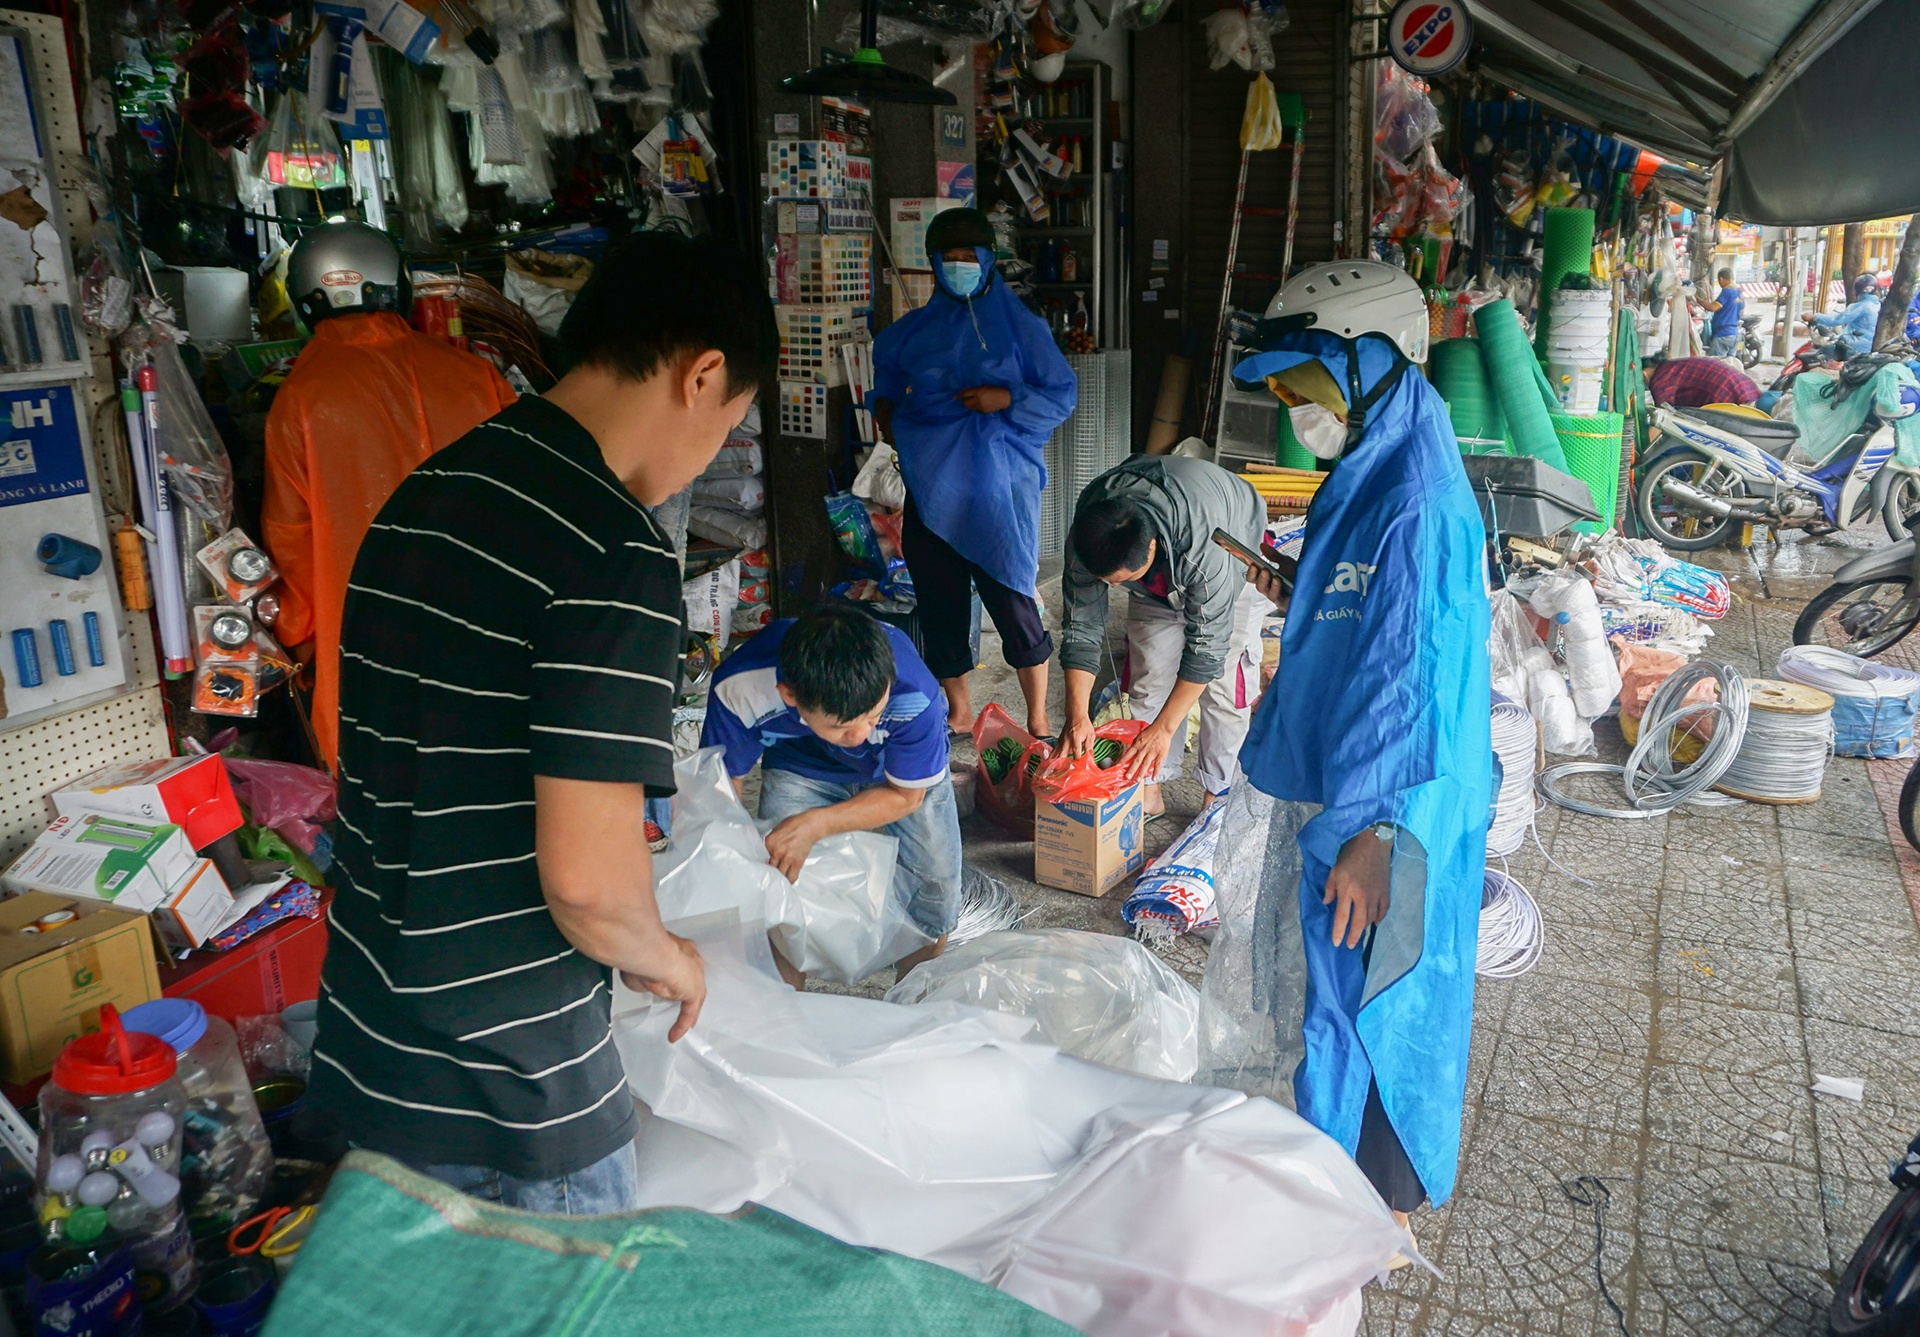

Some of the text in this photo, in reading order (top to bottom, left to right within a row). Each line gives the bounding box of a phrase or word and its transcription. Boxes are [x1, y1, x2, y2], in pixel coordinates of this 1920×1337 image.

[1403, 6, 1452, 57] EXPO
[944, 114, 964, 139] 327
[50, 479, 85, 493] LẠNH
[712, 609, 720, 625] CON
[1037, 814, 1068, 827] Panasonic
[57, 828, 71, 840] LED
[269, 949, 281, 995] SECURITY
